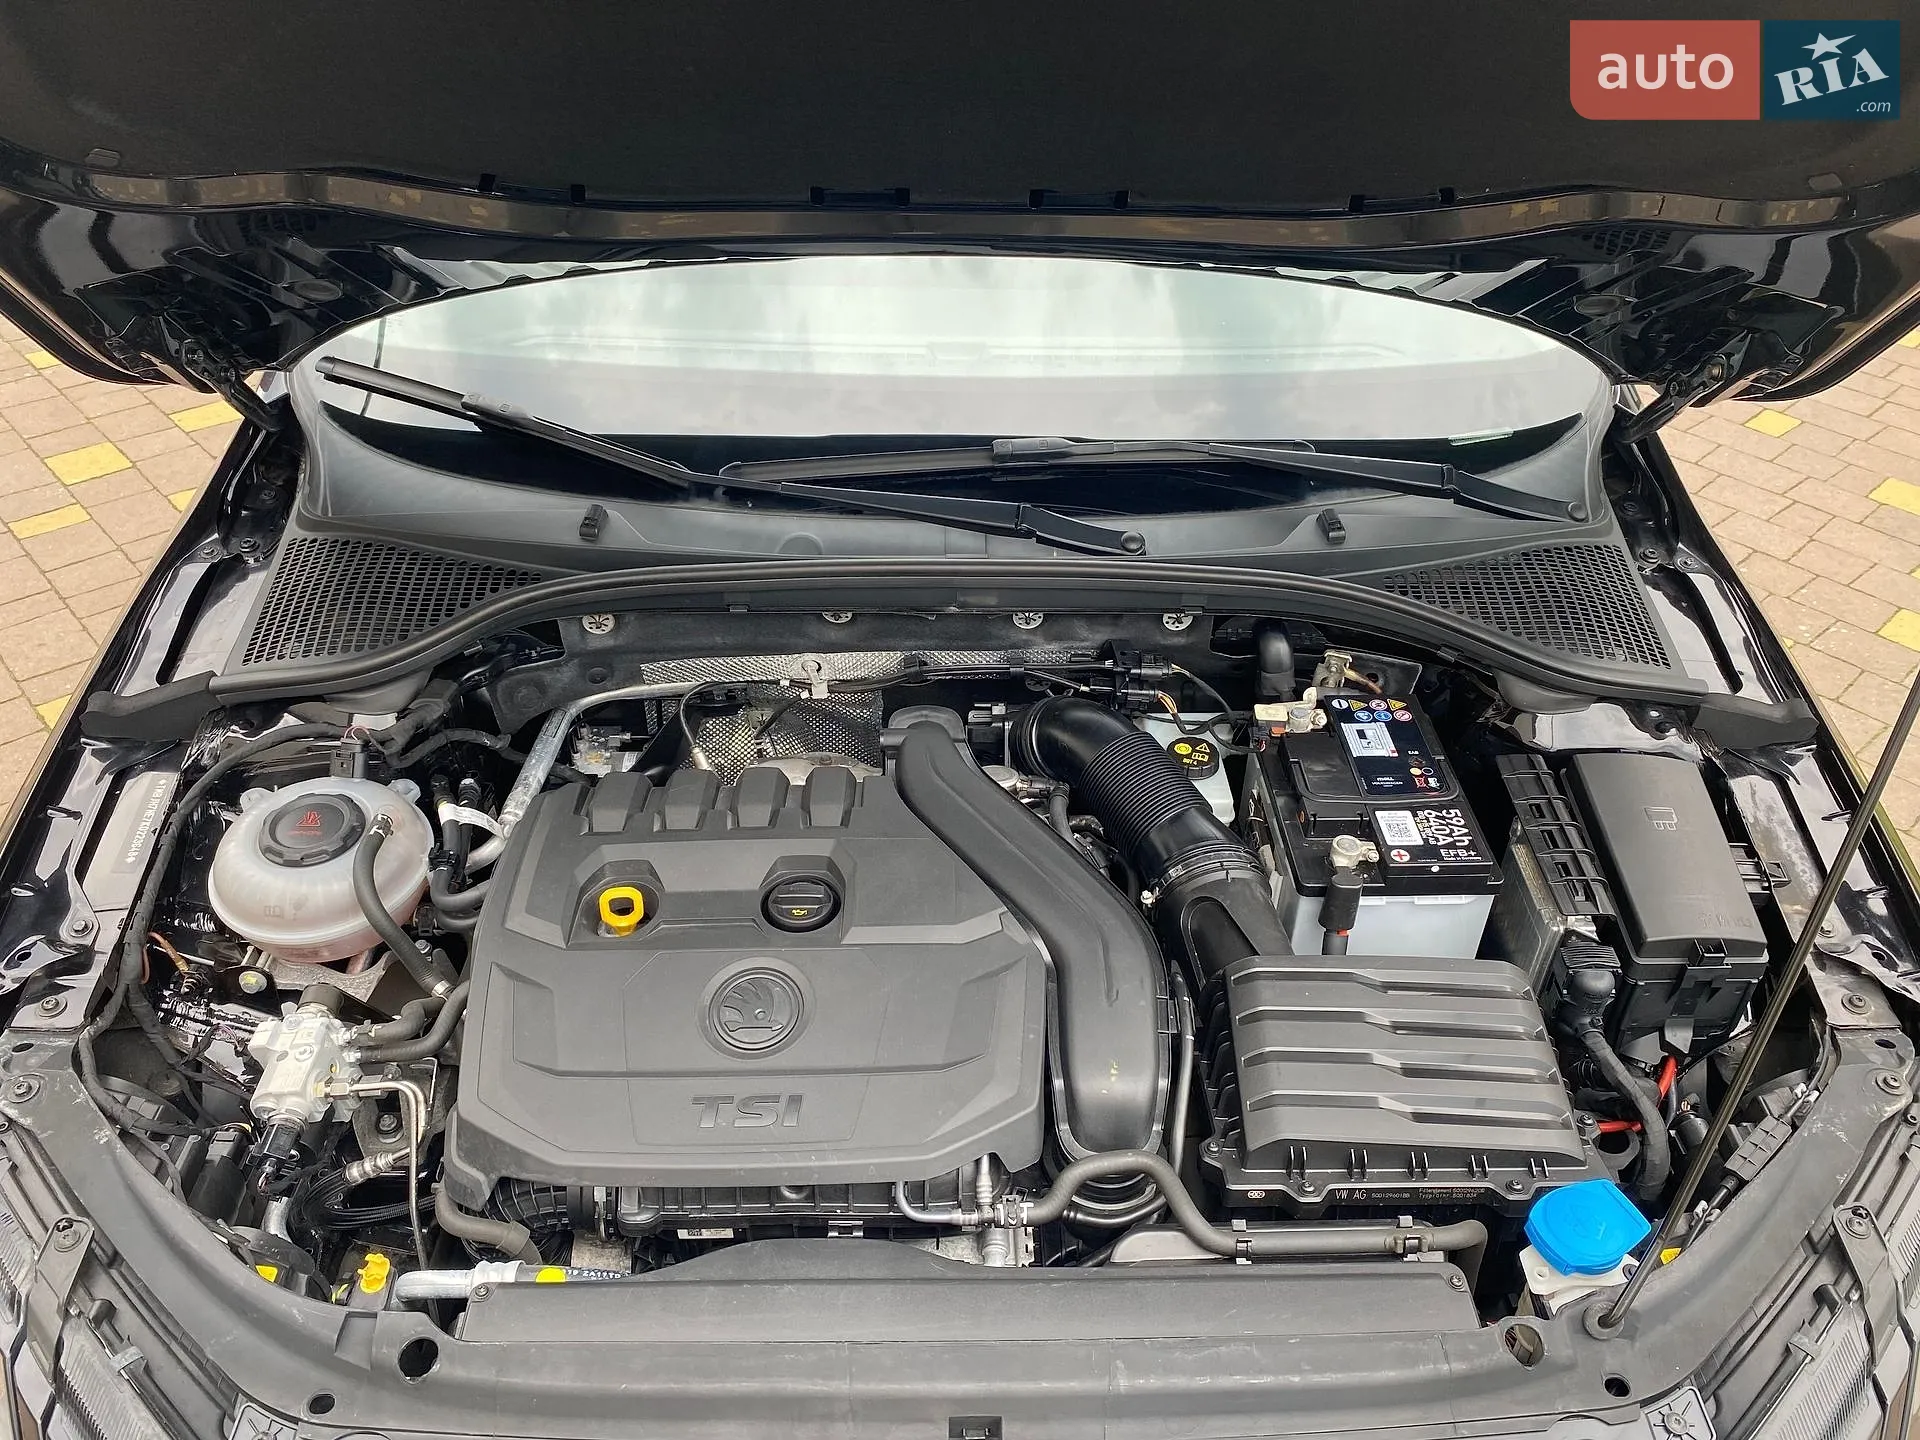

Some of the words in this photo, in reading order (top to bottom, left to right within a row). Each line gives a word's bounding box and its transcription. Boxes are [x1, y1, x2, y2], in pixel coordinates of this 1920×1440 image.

[1424, 809, 1454, 846] 640A
[1442, 809, 1473, 846] 59Ah
[1439, 848, 1477, 856] EFB+
[692, 1095, 803, 1128] TSI
[1334, 1189, 1348, 1200] VW
[1352, 1189, 1366, 1200] AG
